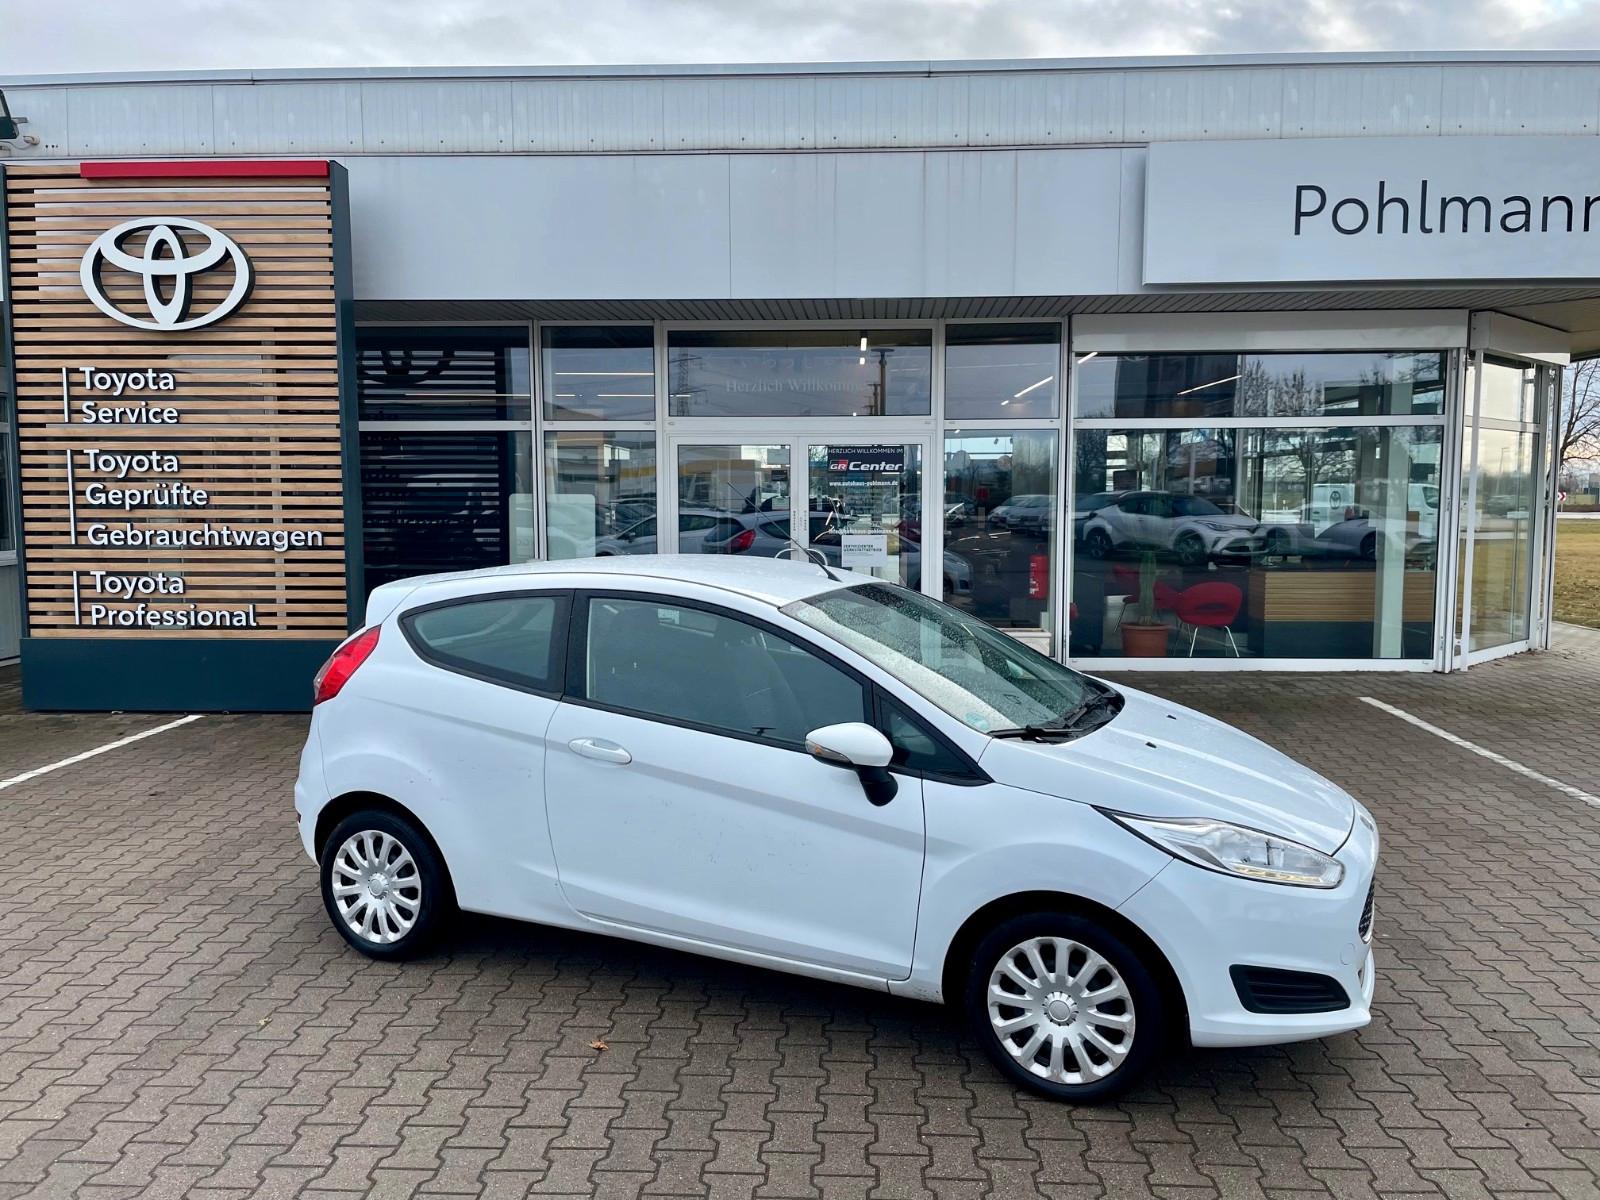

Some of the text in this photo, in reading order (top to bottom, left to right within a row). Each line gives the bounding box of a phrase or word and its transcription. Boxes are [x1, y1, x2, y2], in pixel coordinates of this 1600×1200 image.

[79, 366, 176, 394] Toyota
[81, 401, 179, 424] Service
[83, 449, 179, 477] Toyota
[849, 461, 903, 471] Center
[85, 482, 209, 510] Geprüfte
[87, 523, 324, 551] Gebrauchtwagen
[90, 571, 185, 599] Toyota
[91, 604, 257, 627] Professional
